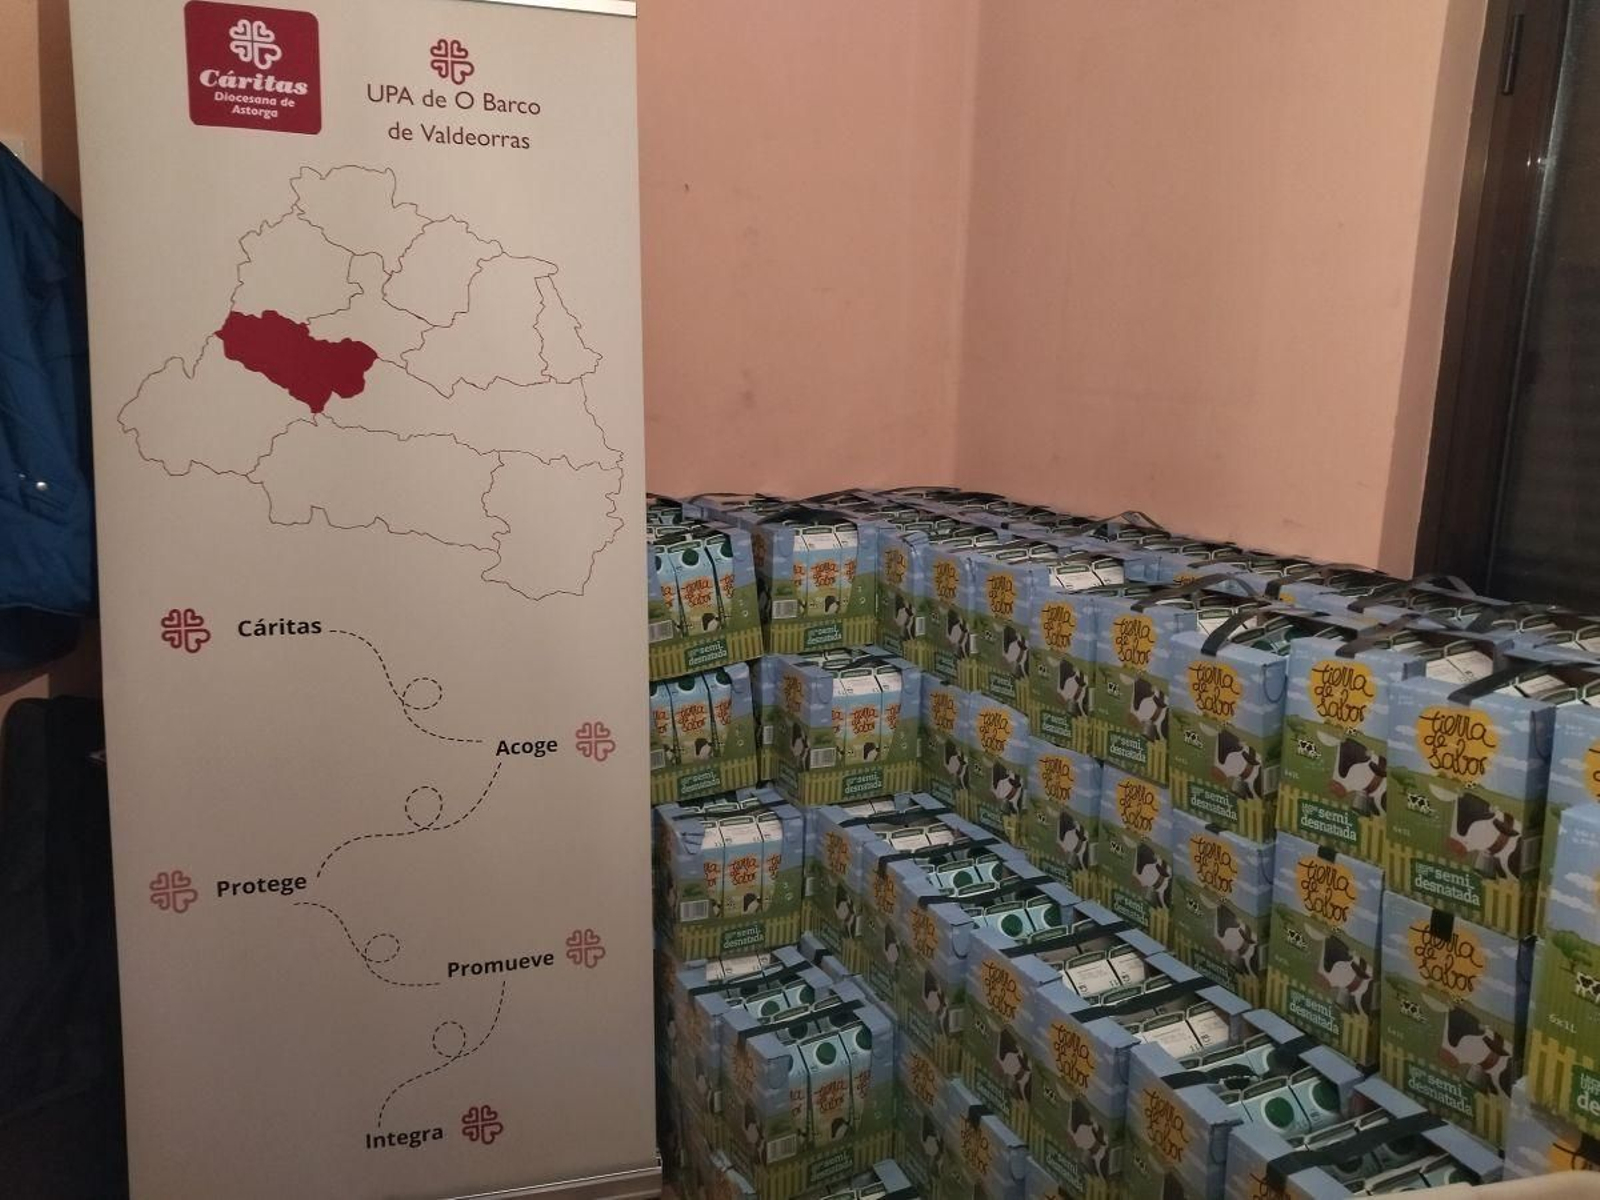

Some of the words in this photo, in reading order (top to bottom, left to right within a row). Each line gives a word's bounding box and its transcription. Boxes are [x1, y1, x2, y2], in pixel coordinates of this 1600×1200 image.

[200, 69, 308, 95] Cáritas
[214, 91, 277, 106] Diocesana
[281, 98, 295, 108] de
[232, 105, 278, 119] Astorga
[367, 84, 414, 106] UPA
[422, 89, 447, 108] de
[455, 91, 474, 110] O
[483, 93, 541, 115] Barco
[388, 121, 413, 141] de
[420, 123, 530, 149] Valdeorras
[238, 618, 322, 637] Cáritas
[1189, 664, 1240, 695] tierra
[1312, 664, 1374, 698] tierra
[1197, 687, 1236, 717] sabor
[1317, 690, 1367, 722] sabor
[1419, 711, 1496, 748] tierra
[495, 739, 558, 758] Acoge
[1428, 739, 1488, 776] sabor
[217, 876, 307, 897] Protege
[1298, 861, 1355, 901] tierra
[1304, 889, 1349, 921] sabor
[448, 952, 554, 978] Promueve
[1418, 955, 1477, 992] sabor
[366, 1127, 443, 1149] Integra
